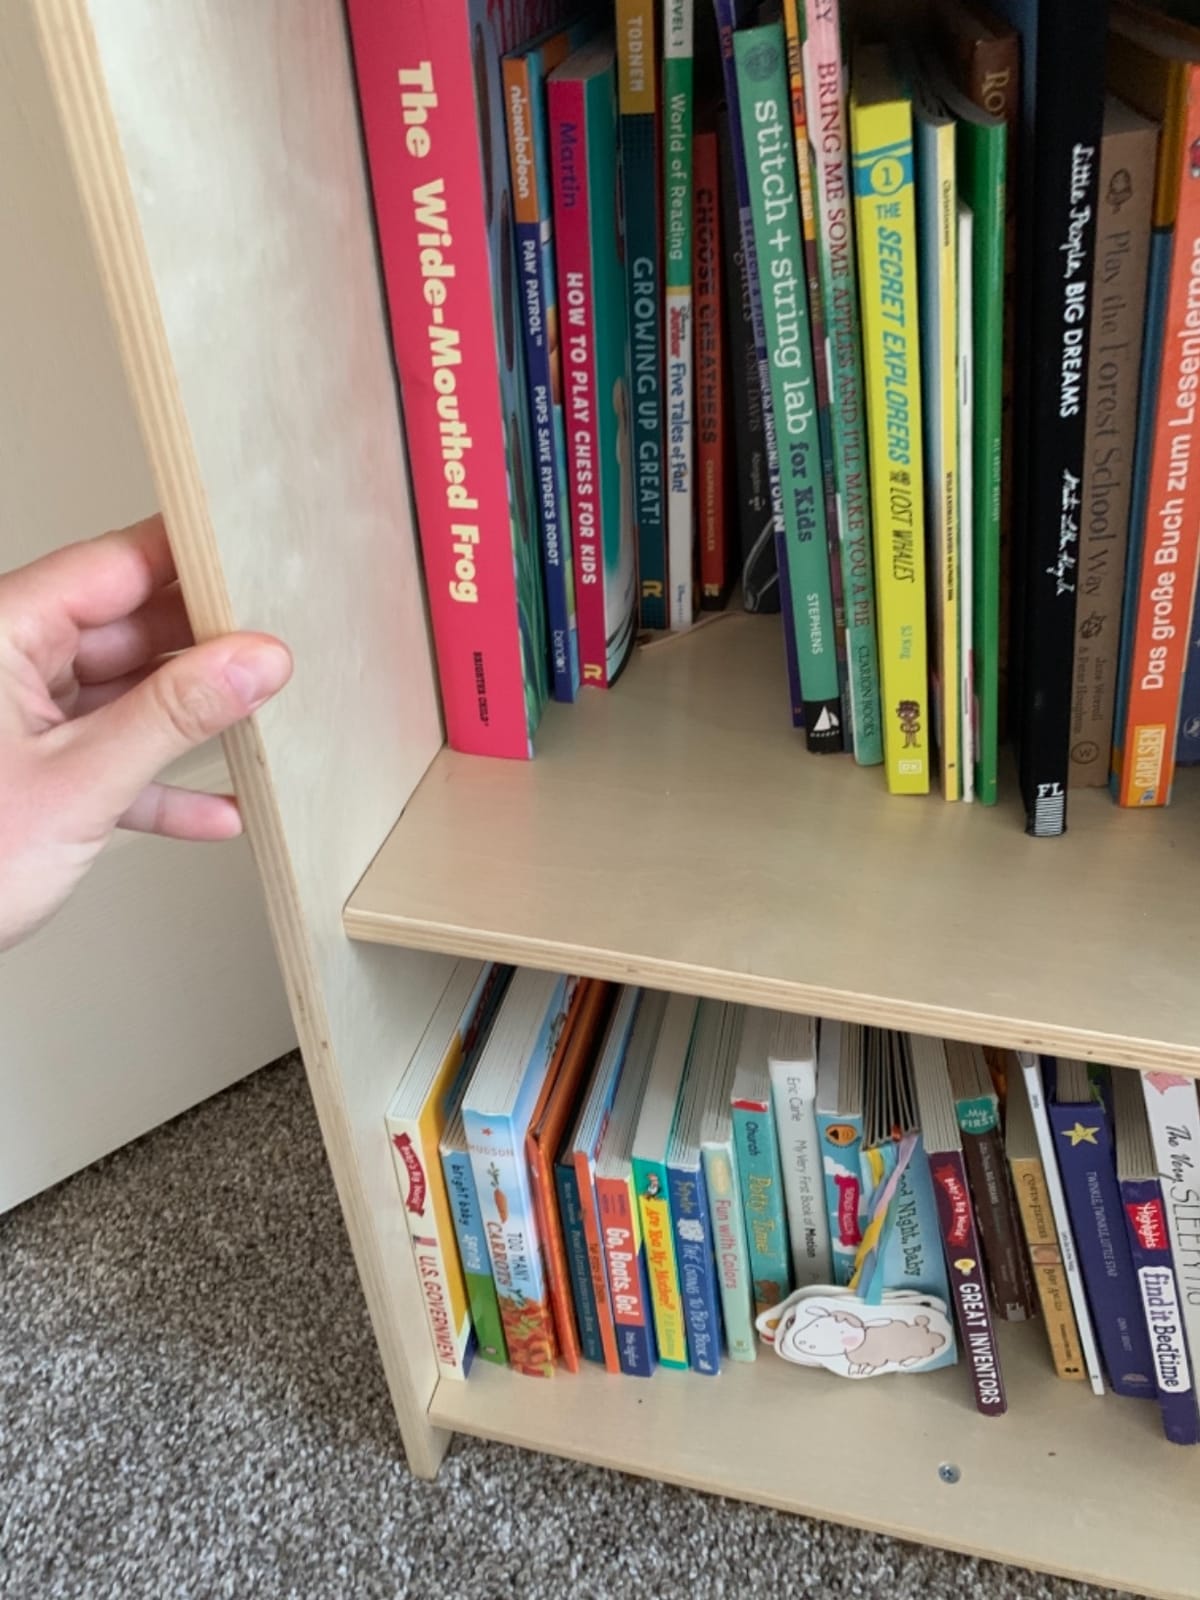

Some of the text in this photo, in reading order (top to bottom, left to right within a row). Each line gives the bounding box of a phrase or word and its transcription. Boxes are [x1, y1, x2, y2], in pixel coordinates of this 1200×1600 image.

[671, 0, 685, 33] EVEL
[627, 16, 645, 92] TODNEM
[982, 71, 1009, 119] RO
[510, 85, 529, 199] nickelodeon
[560, 122, 580, 208] Martin
[669, 94, 687, 260] World of Reading
[882, 166, 893, 186] 1
[1071, 142, 1095, 205] Little
[522, 240, 536, 272] PAW
[697, 188, 717, 443] CHOOSE GREATNESS
[754, 100, 816, 543] stitch + string lab for Kids
[1064, 282, 1087, 324] BIG
[398, 61, 479, 603] The Wide-Mouthed Frog
[817, 61, 870, 628] BRING ME SOME APPLES AND I'LL MAKE YOU A PIE
[875, 202, 911, 465] THE SECRET EXPLORERS
[633, 257, 660, 525] GROWING UP GREAT!
[671, 363, 686, 396] Five
[1059, 328, 1083, 418] DREAMS
[567, 272, 596, 585] HOW TO PLAY CHESS FOR KIDS
[671, 402, 690, 443] Tales
[1086, 231, 1130, 597] Play the Forest School Way
[535, 385, 559, 565] PUPS SAVE RYDER'S ROBOT
[671, 463, 688, 494] Fun!
[672, 446, 685, 459] of
[1141, 236, 1200, 690] Das große Buch zum Lesenlernen
[890, 487, 912, 526] LOST
[893, 529, 915, 583] WHALES
[807, 593, 824, 655] STEPHENS
[858, 646, 873, 738] CLARION BOOKS
[1135, 729, 1161, 788] CARLSEN
[1037, 783, 1064, 798] FL
[787, 1076, 803, 1121] Eric Carle
[961, 1115, 994, 1129] FIRST
[745, 1121, 759, 1157] Church
[1165, 1124, 1192, 1155] The
[451, 1164, 472, 1226] bright baby
[749, 1175, 773, 1218] Potty
[1159, 1155, 1193, 1184] Very
[645, 1206, 660, 1226] Are
[794, 1139, 817, 1257] My Very First Book of Motion
[896, 1200, 920, 1245] Night,
[1085, 1172, 1117, 1277] TWINKLE, TWINKLE, LITTLE STAR
[463, 1234, 481, 1270] spring
[606, 1227, 630, 1250] Go,
[650, 1229, 663, 1247] You
[715, 1200, 738, 1291] Fun with Colors
[1134, 1203, 1157, 1248] Highlights
[487, 1222, 512, 1288] CARROTS
[507, 1232, 529, 1282] TOO MANY
[611, 1252, 632, 1297] Boots,
[650, 1250, 667, 1267] My
[904, 1246, 928, 1277] Baby
[424, 1280, 457, 1368] GOVERNMENT
[616, 1299, 639, 1317] Go!
[684, 1244, 711, 1356] THE GOING TO BED BOOK
[959, 1283, 1000, 1405] GREAT INVENTORS
[1143, 1272, 1178, 1388] find it Bedtime
